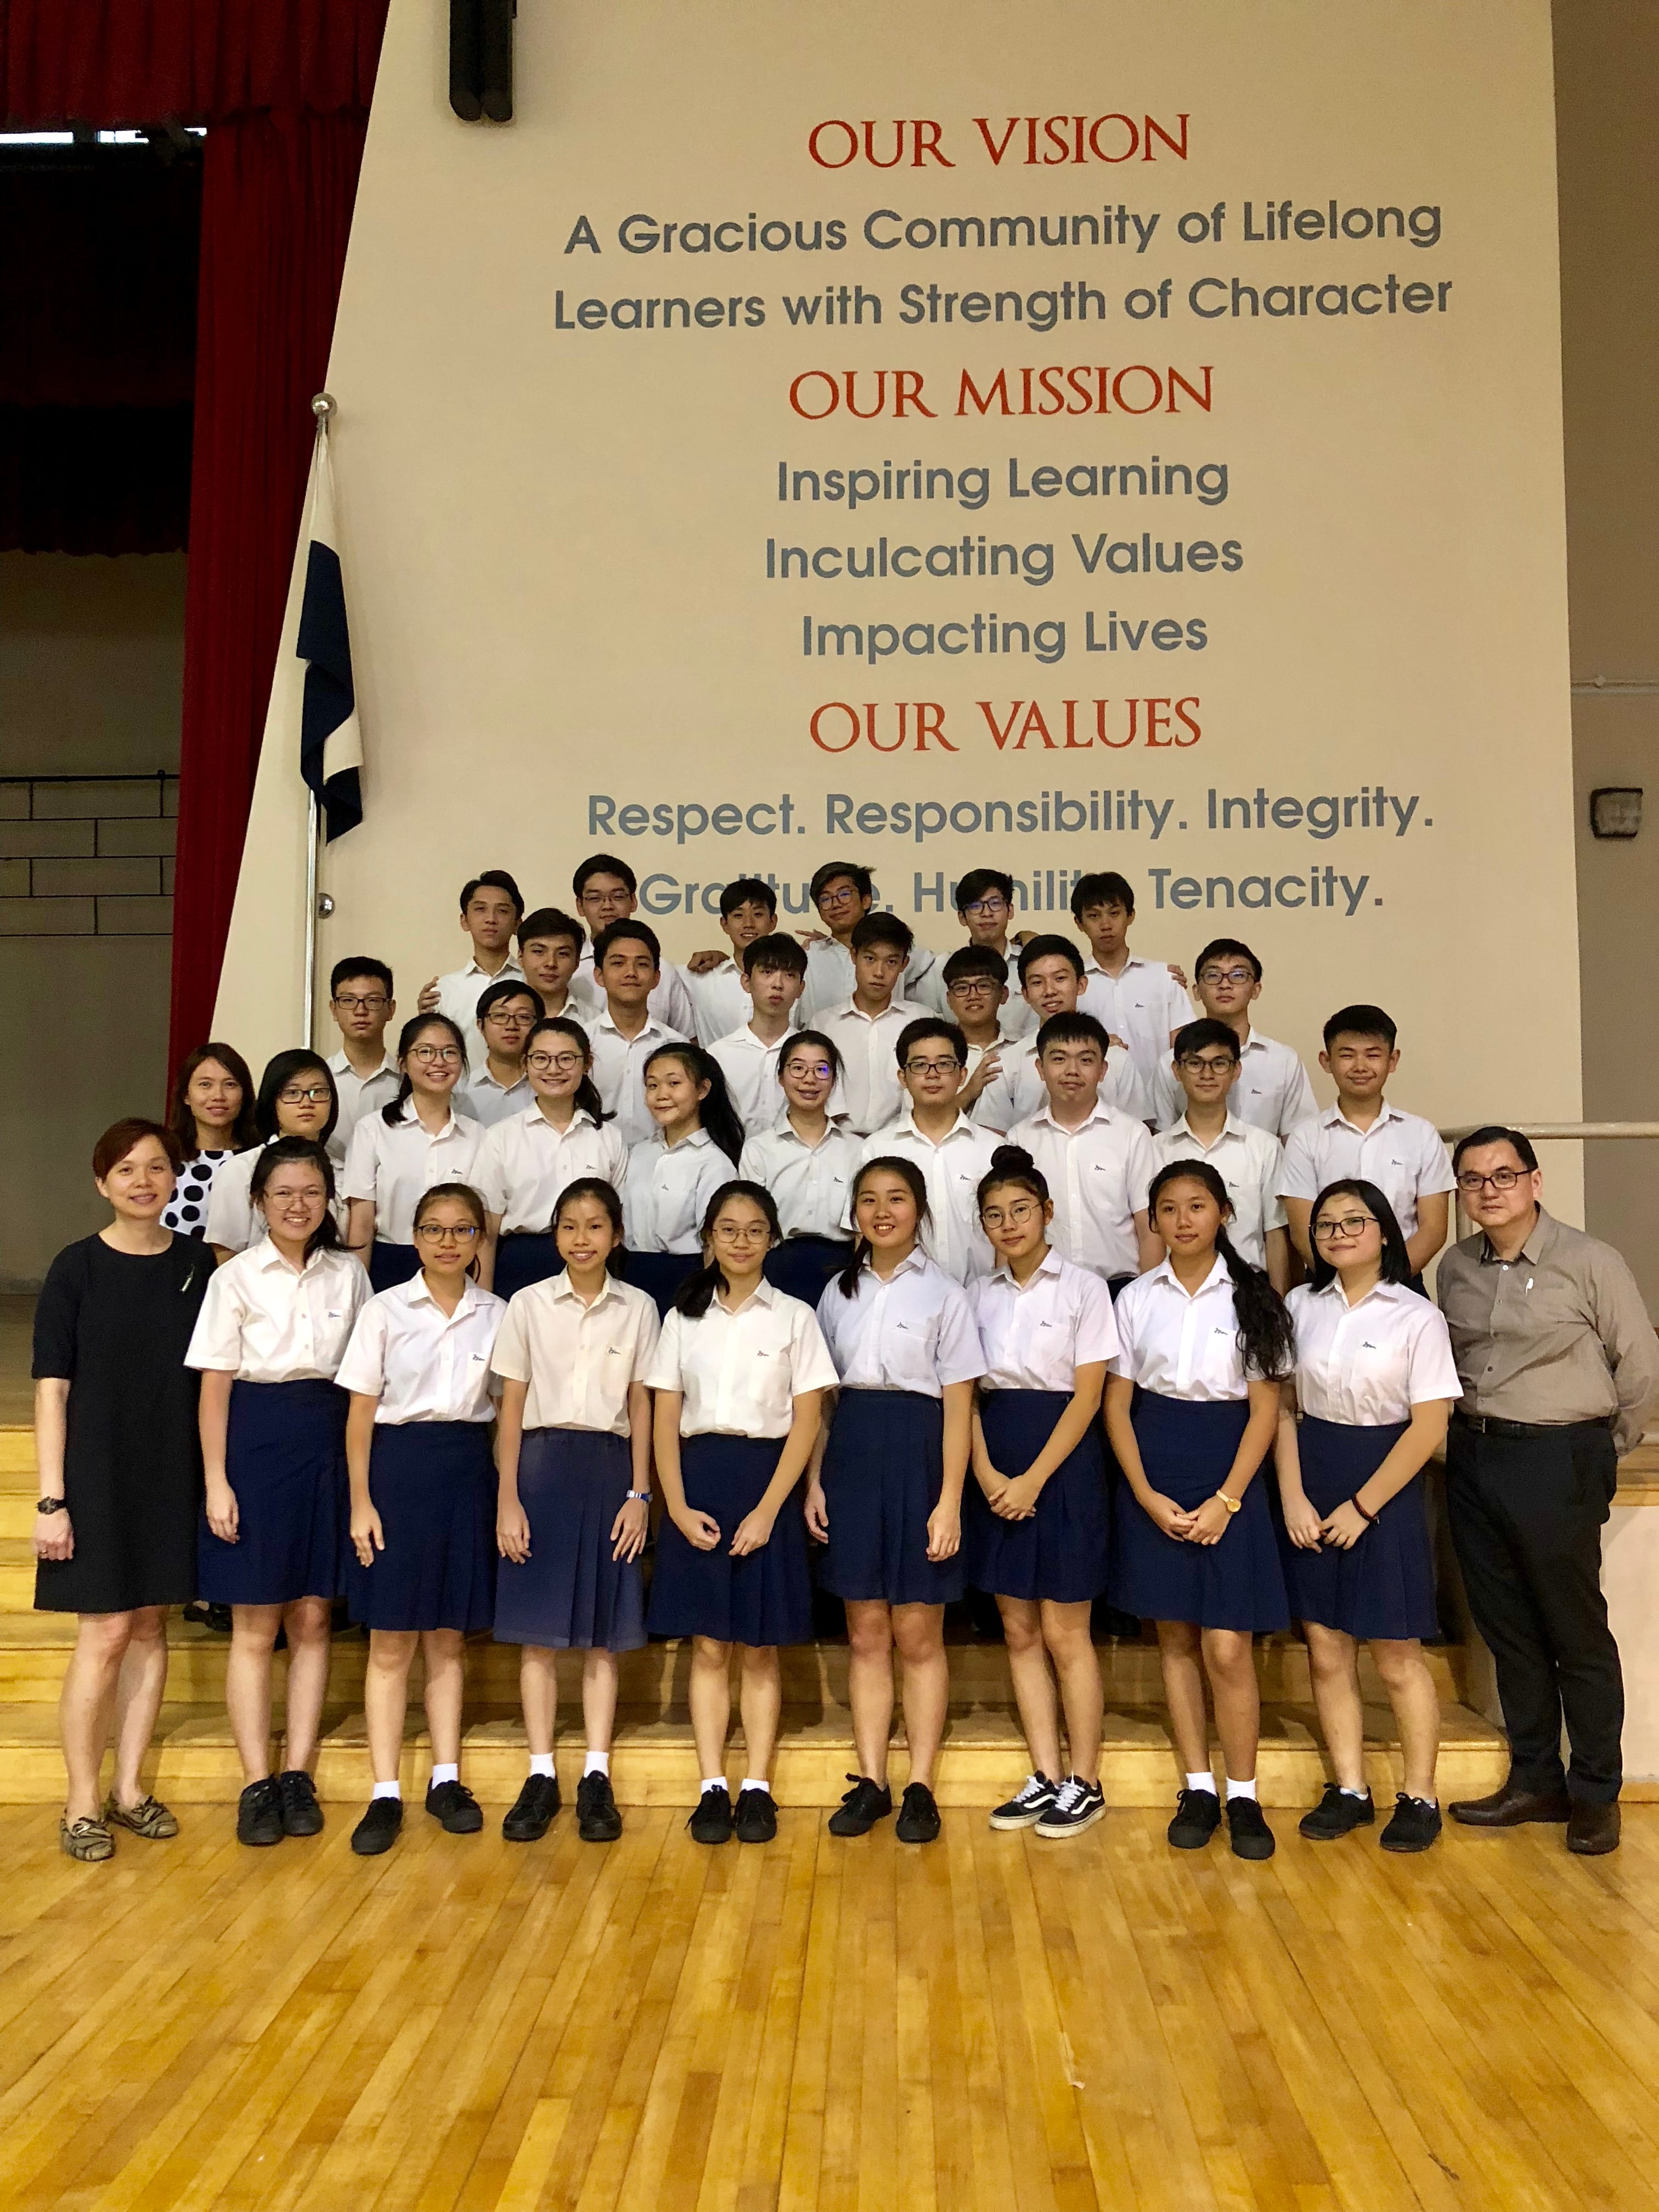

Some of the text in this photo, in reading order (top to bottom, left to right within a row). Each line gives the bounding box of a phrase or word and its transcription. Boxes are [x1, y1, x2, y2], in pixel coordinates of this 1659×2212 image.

[809, 114, 1190, 168] OUR VISION
[564, 215, 601, 254] A
[864, 205, 1160, 253] Community
[1178, 202, 1226, 243] of
[1244, 200, 1441, 247] Lifelong
[556, 274, 1452, 332] Learners with Strength of Character
[790, 365, 1214, 420] OUR MISSION
[779, 456, 1228, 510] Inspiring Learning
[767, 533, 1243, 586] Inculcating Values
[804, 611, 1207, 664] Impacting Lives
[810, 697, 1201, 753] OUR VALUES
[589, 786, 1432, 844] Respect. Responsibility. Integrity.
[1148, 866, 1383, 916] Tenacity.
